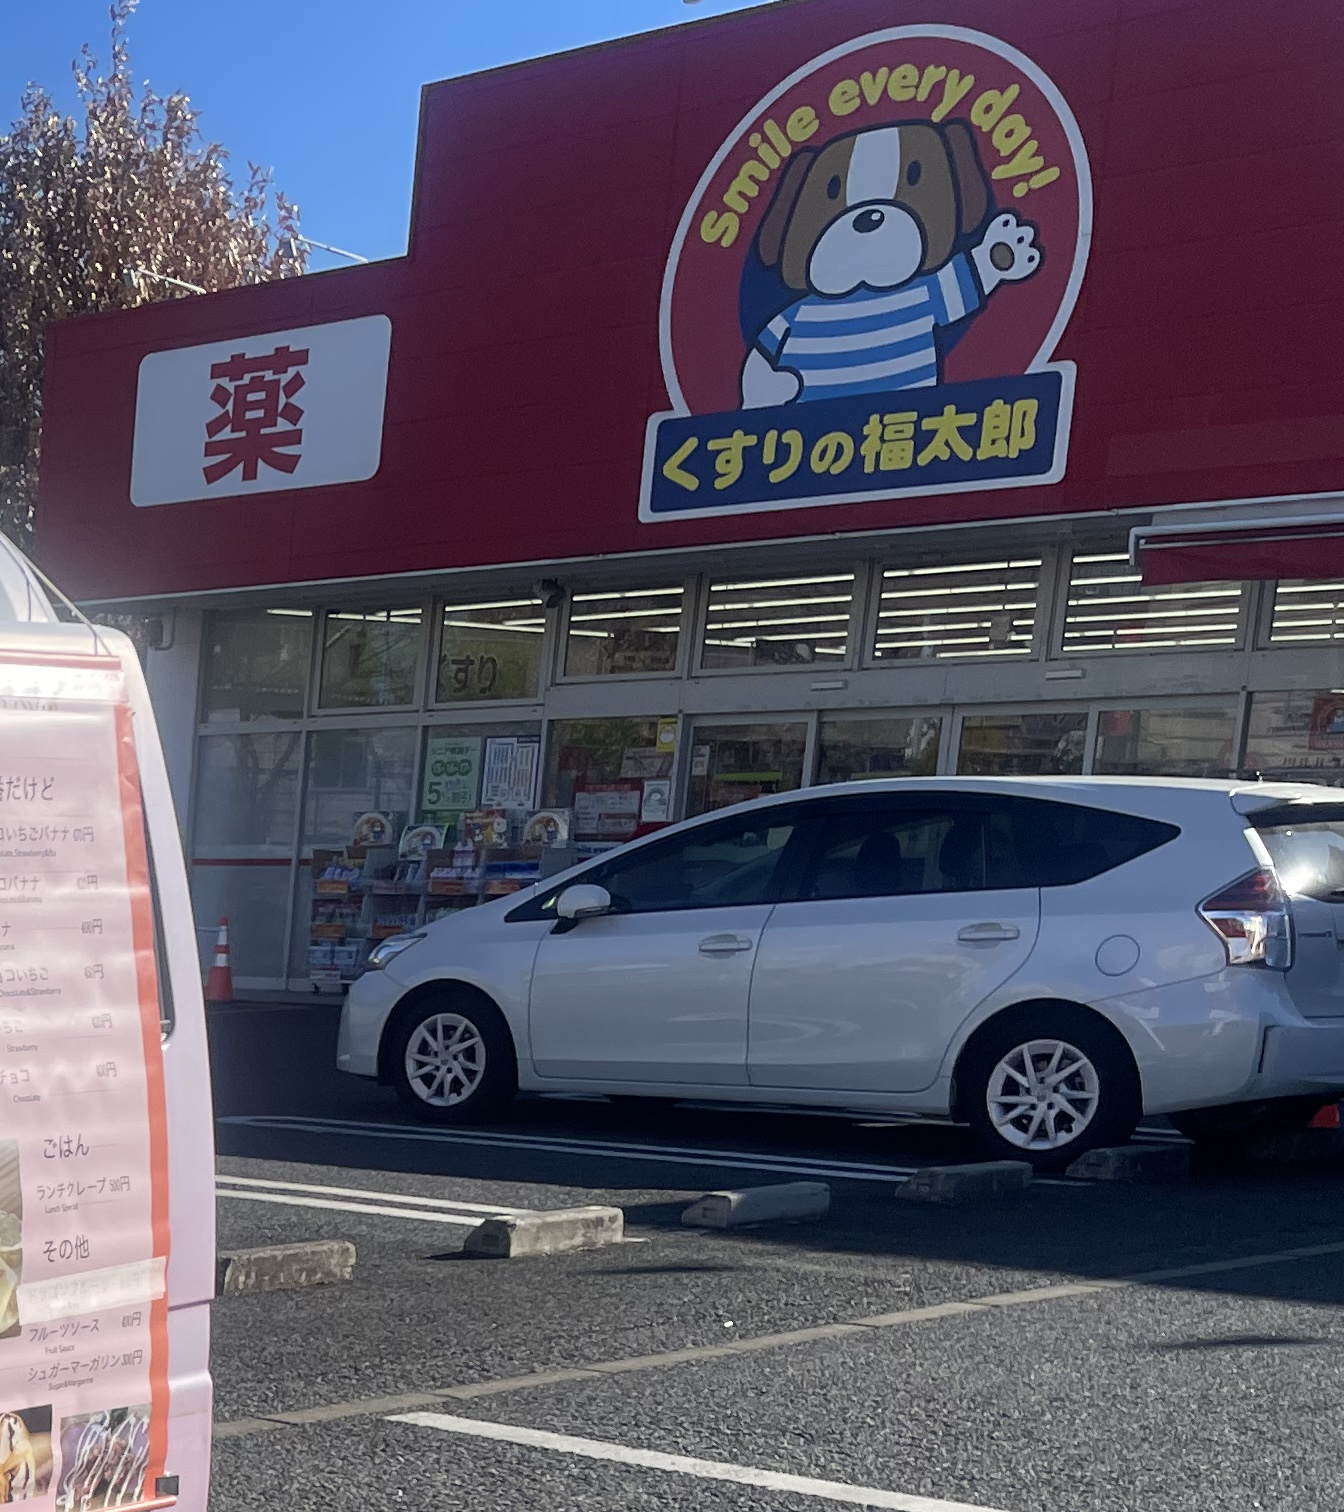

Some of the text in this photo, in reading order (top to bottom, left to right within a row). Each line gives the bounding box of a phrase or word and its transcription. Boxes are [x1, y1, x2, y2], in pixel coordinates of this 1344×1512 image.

[700, 63, 1060, 248] Smile every day!
[202, 344, 310, 485] 薬
[662, 399, 1039, 492] くすりの福太郎
[43, 1133, 90, 1160] ごはん
[36, 1176, 107, 1201] ランチクレープ
[42, 1234, 91, 1263] その他
[28, 1318, 100, 1342] フルーツソース
